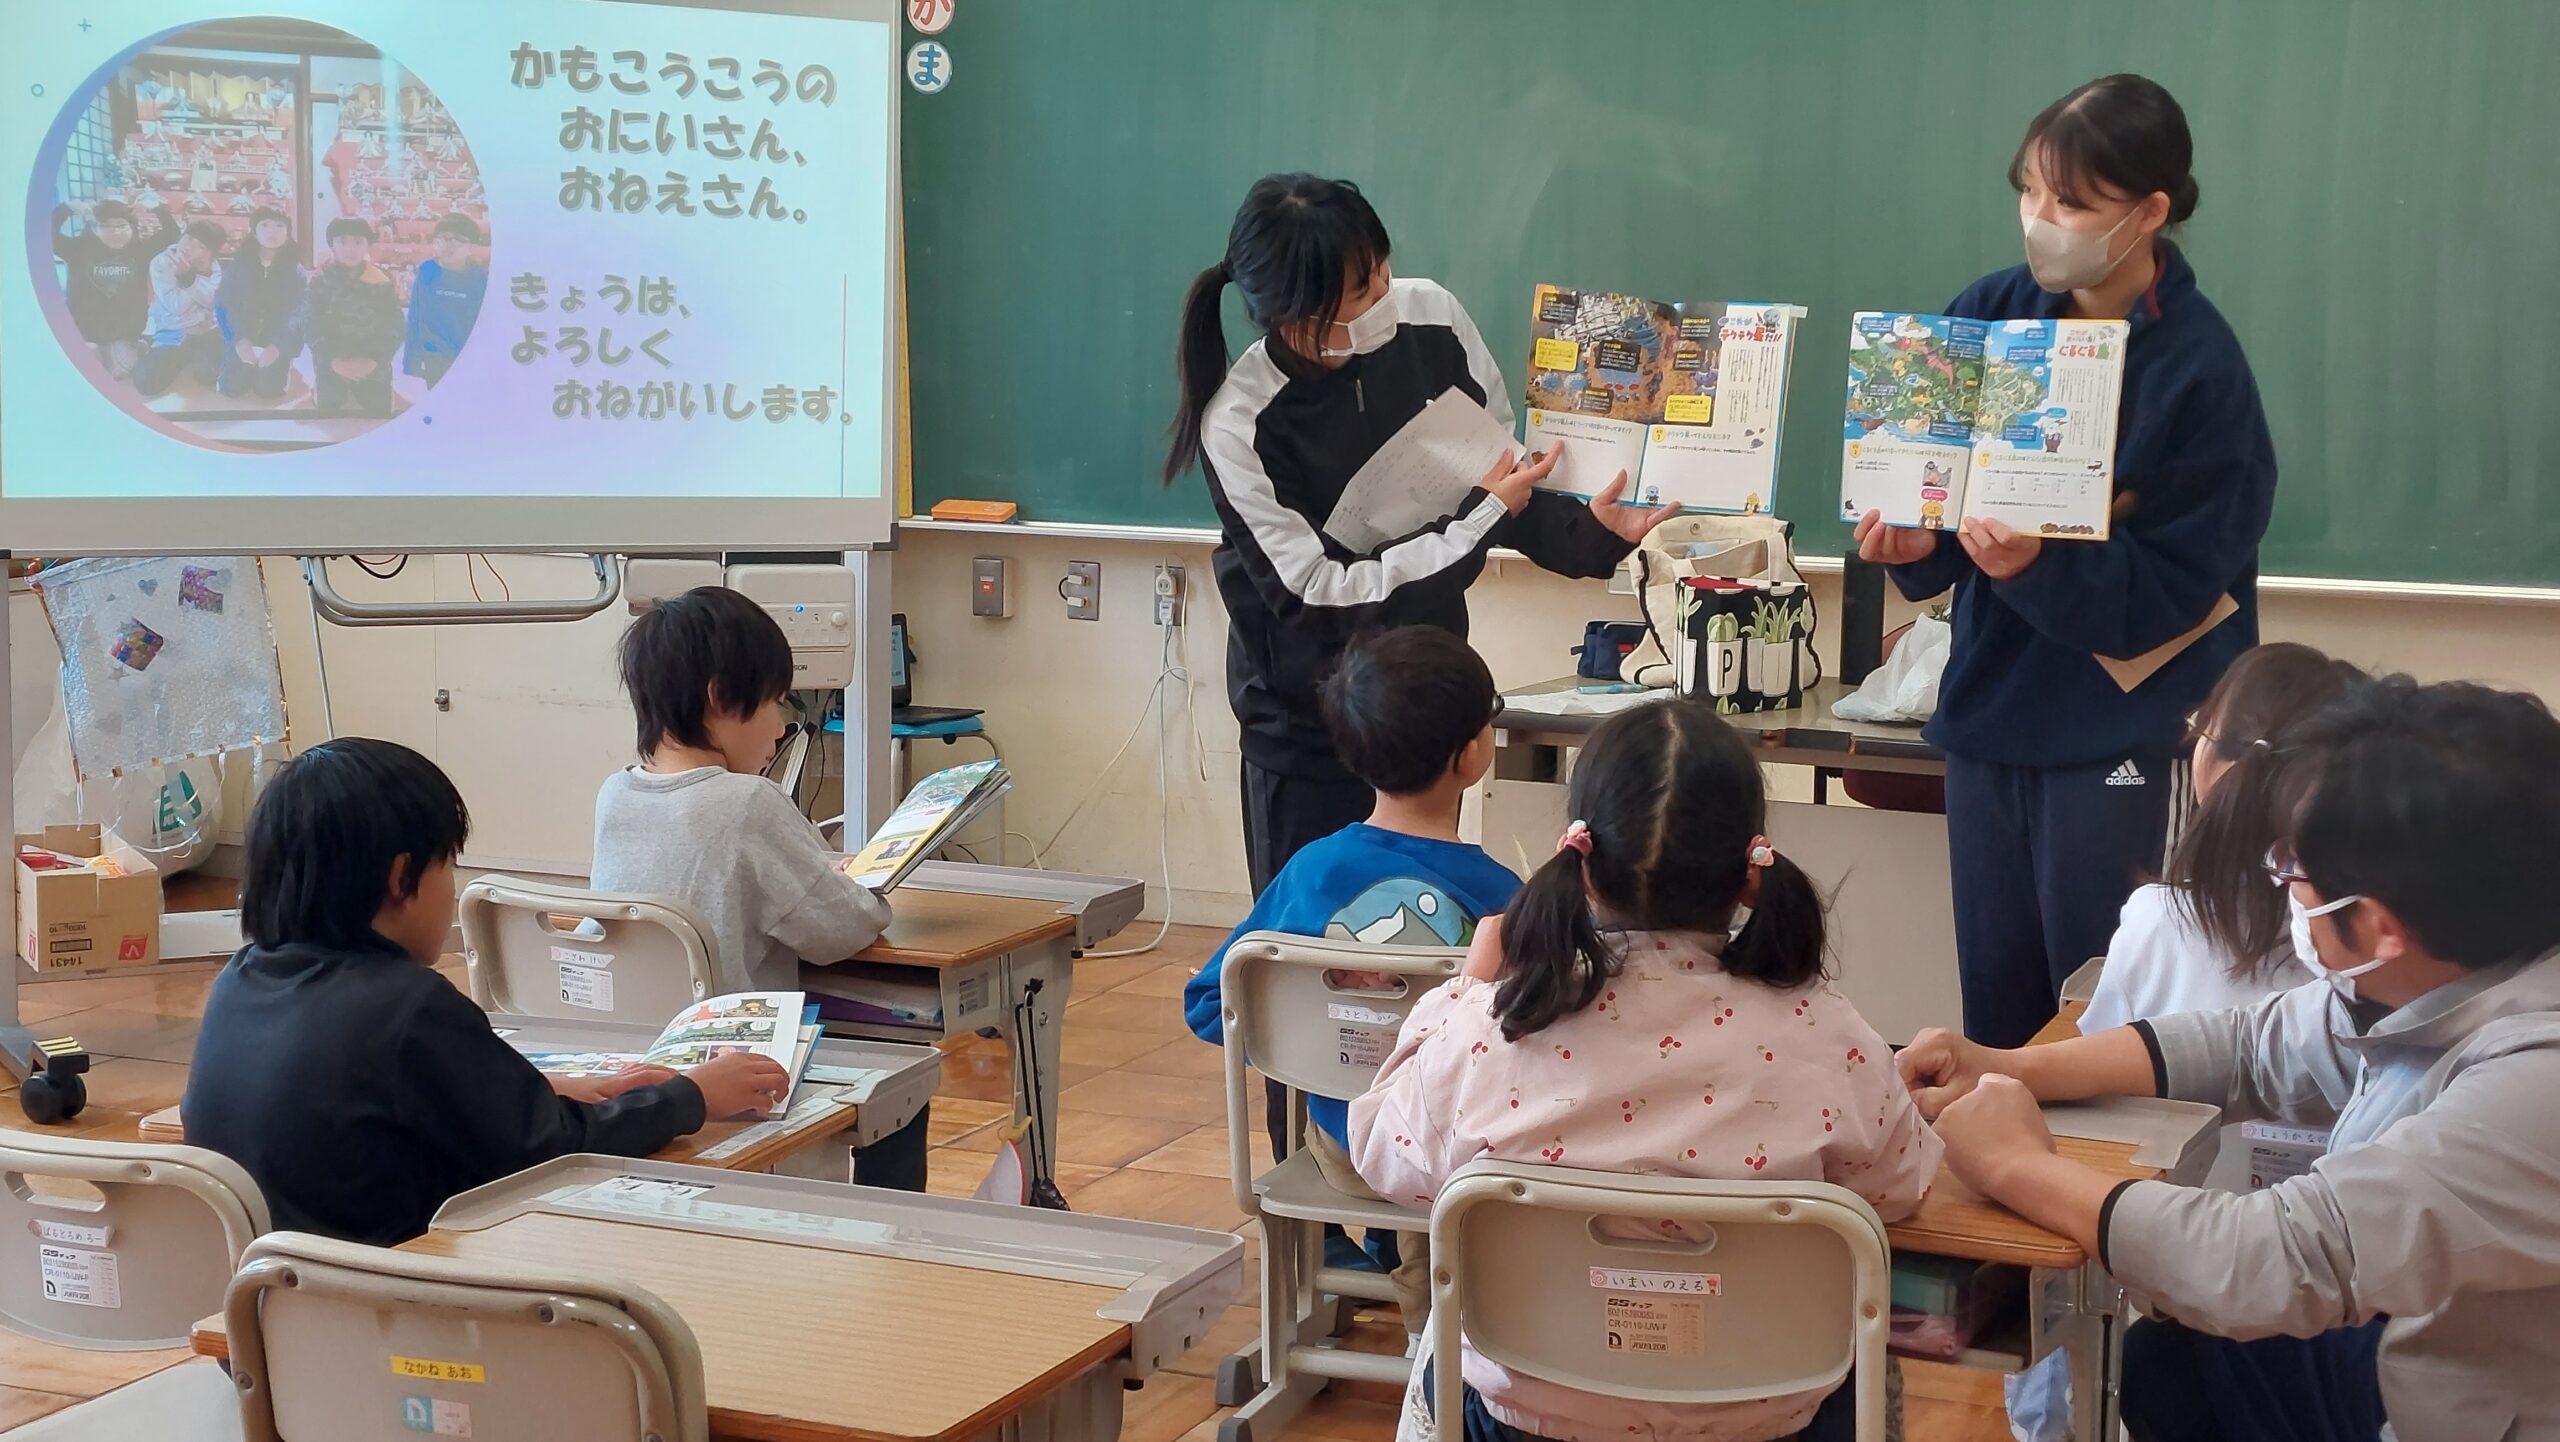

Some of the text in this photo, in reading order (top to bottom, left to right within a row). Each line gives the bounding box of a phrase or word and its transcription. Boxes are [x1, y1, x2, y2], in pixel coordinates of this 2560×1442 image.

[510, 41, 837, 108] かもこうこうの
[914, 44, 942, 86] ま
[558, 105, 808, 167] おにいさん、
[558, 165, 808, 225] おねえさん。
[510, 271, 691, 319] きょうは、
[511, 325, 673, 369] よろしく
[552, 378, 853, 425] おねがいします。
[1723, 648, 1733, 689] P
[2105, 775, 2146, 786] adidas
[1612, 1276, 1704, 1292] いまい のえる
